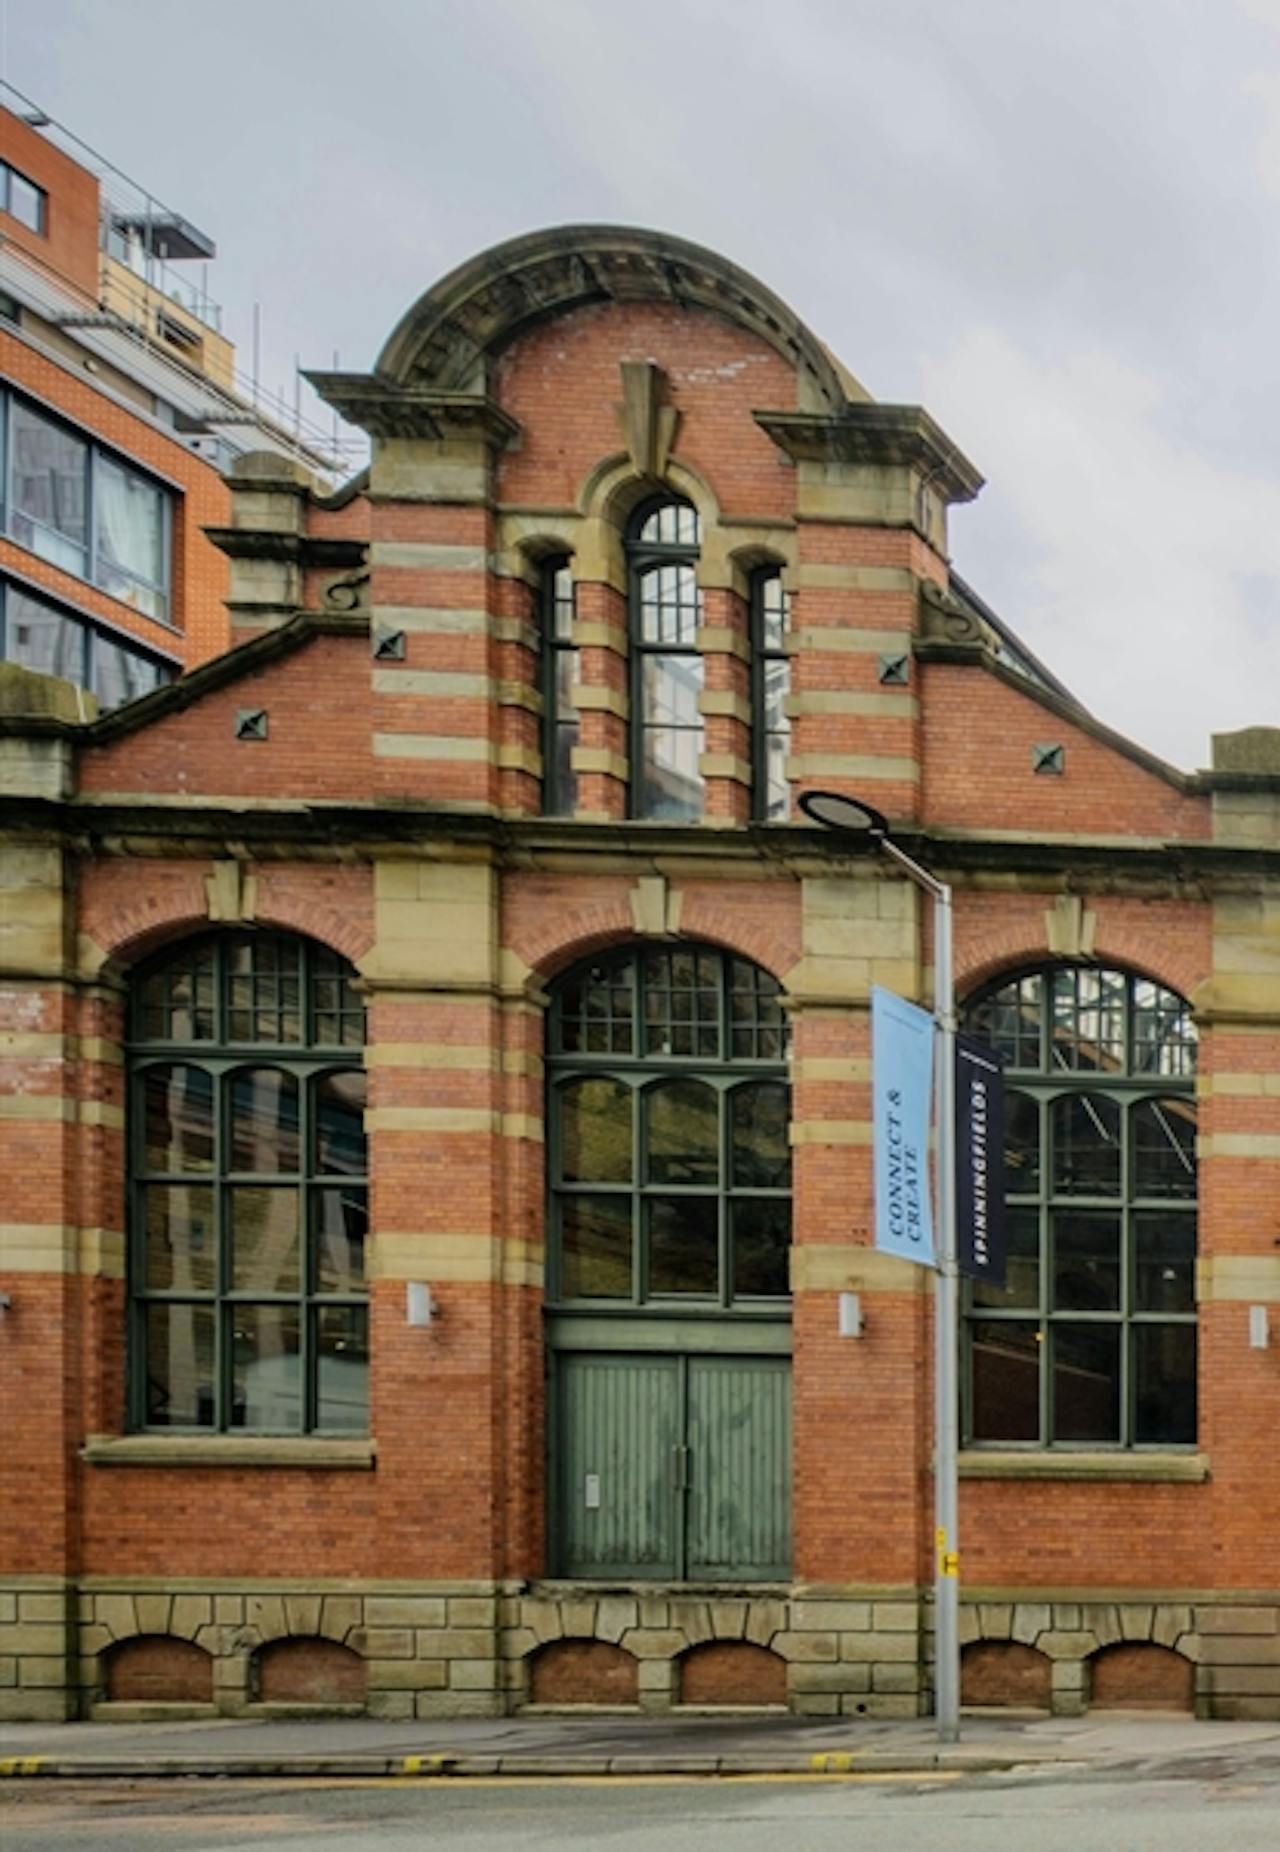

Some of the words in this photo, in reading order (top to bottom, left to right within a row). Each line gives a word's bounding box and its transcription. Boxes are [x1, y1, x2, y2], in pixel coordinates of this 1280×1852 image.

[887, 1088, 901, 1106] &
[888, 1111, 904, 1236] CONNECT
[905, 1145, 922, 1243] CREATE
[971, 1081, 988, 1265] SPINNINGFIELDS
